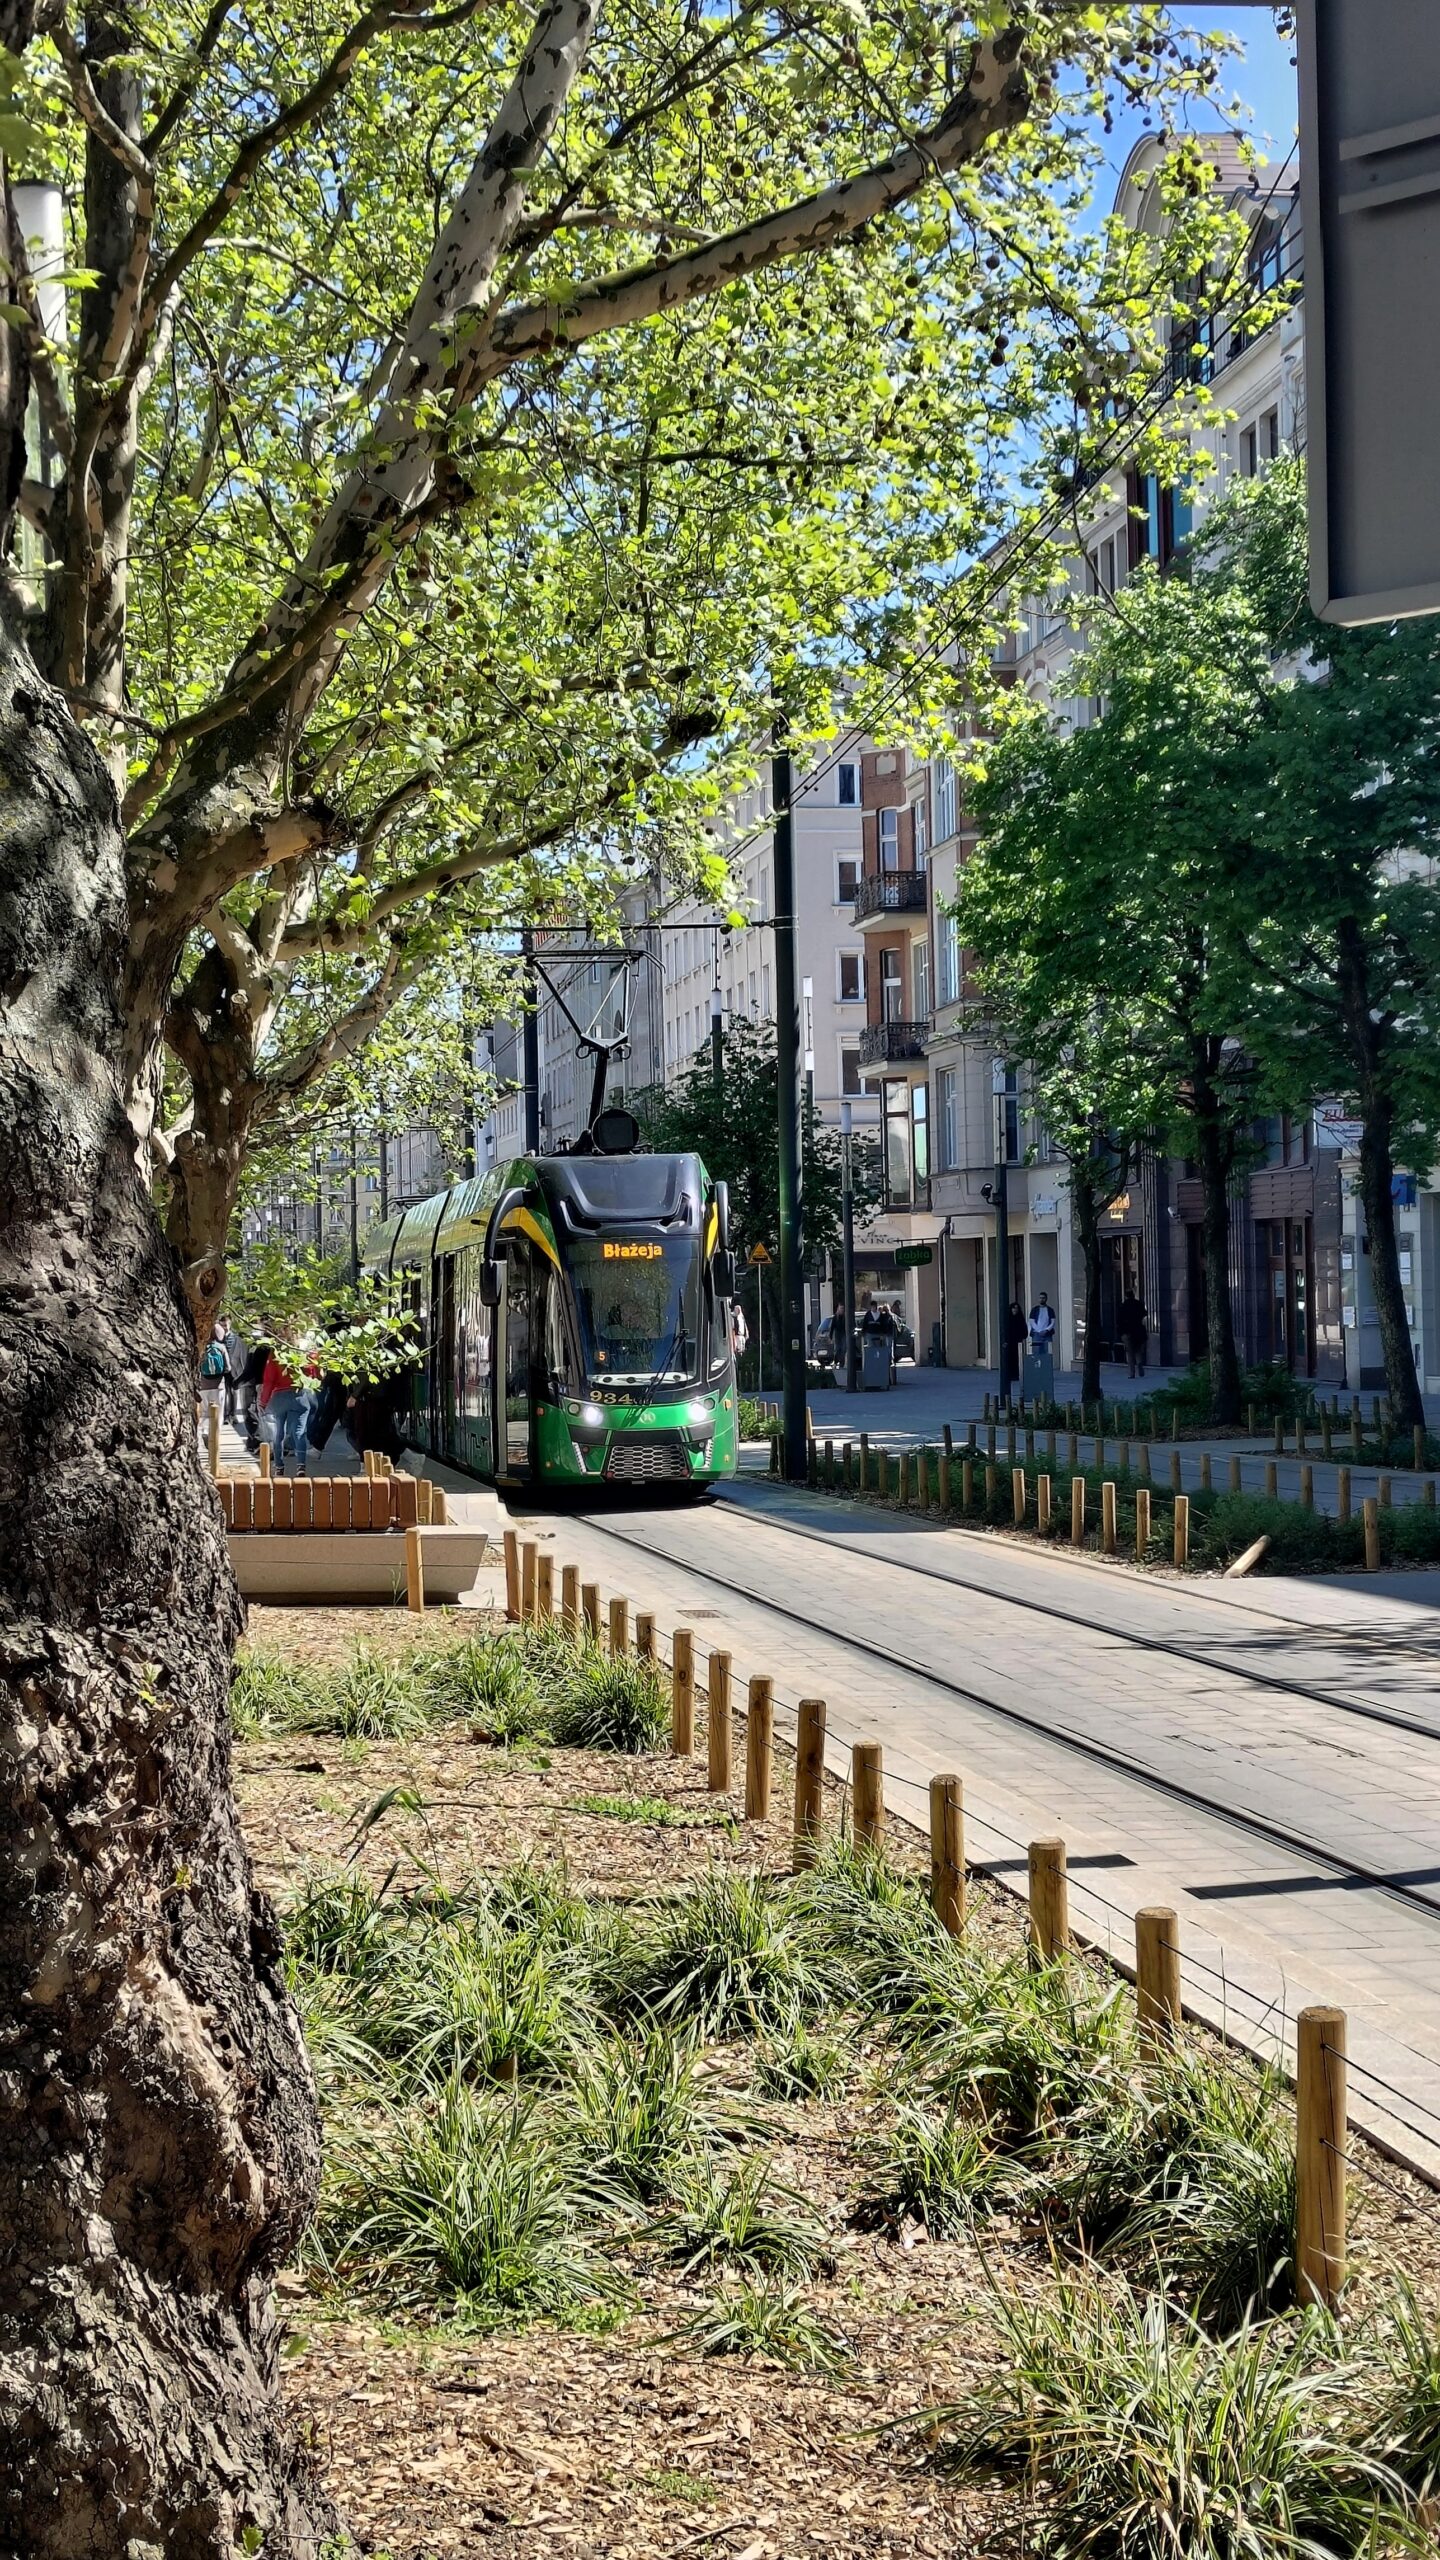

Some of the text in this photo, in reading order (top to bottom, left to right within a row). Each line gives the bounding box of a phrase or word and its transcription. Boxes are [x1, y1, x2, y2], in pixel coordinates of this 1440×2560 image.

[603, 1243, 663, 1259] Błażeja
[598, 1351, 606, 1361] 5
[590, 1390, 634, 1405] 934
